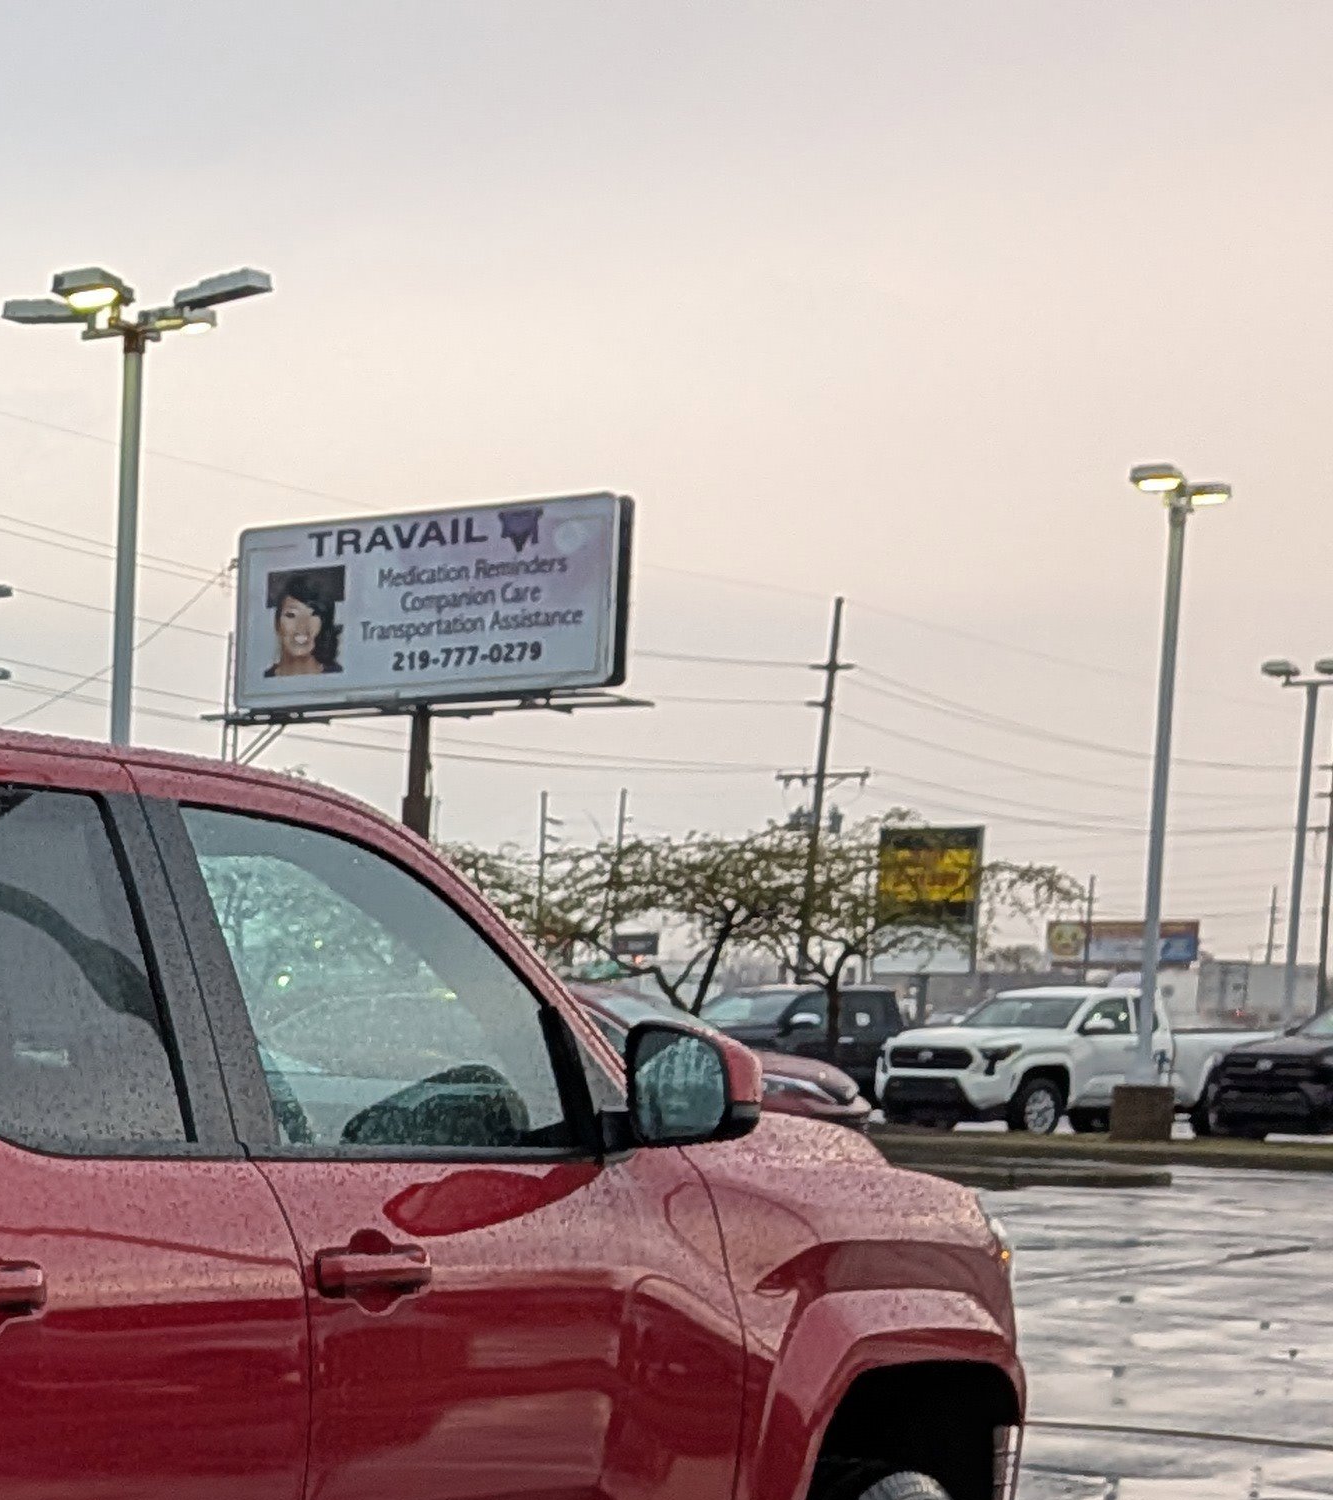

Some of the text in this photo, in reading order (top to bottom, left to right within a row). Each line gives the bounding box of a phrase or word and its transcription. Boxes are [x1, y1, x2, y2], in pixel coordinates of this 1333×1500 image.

[308, 517, 488, 557] TRAVAIL
[378, 556, 568, 588] Medication Reminders
[400, 582, 541, 614] Companion Care
[361, 608, 583, 644] Transportation Assistance
[392, 641, 542, 671] 219-777-0279
